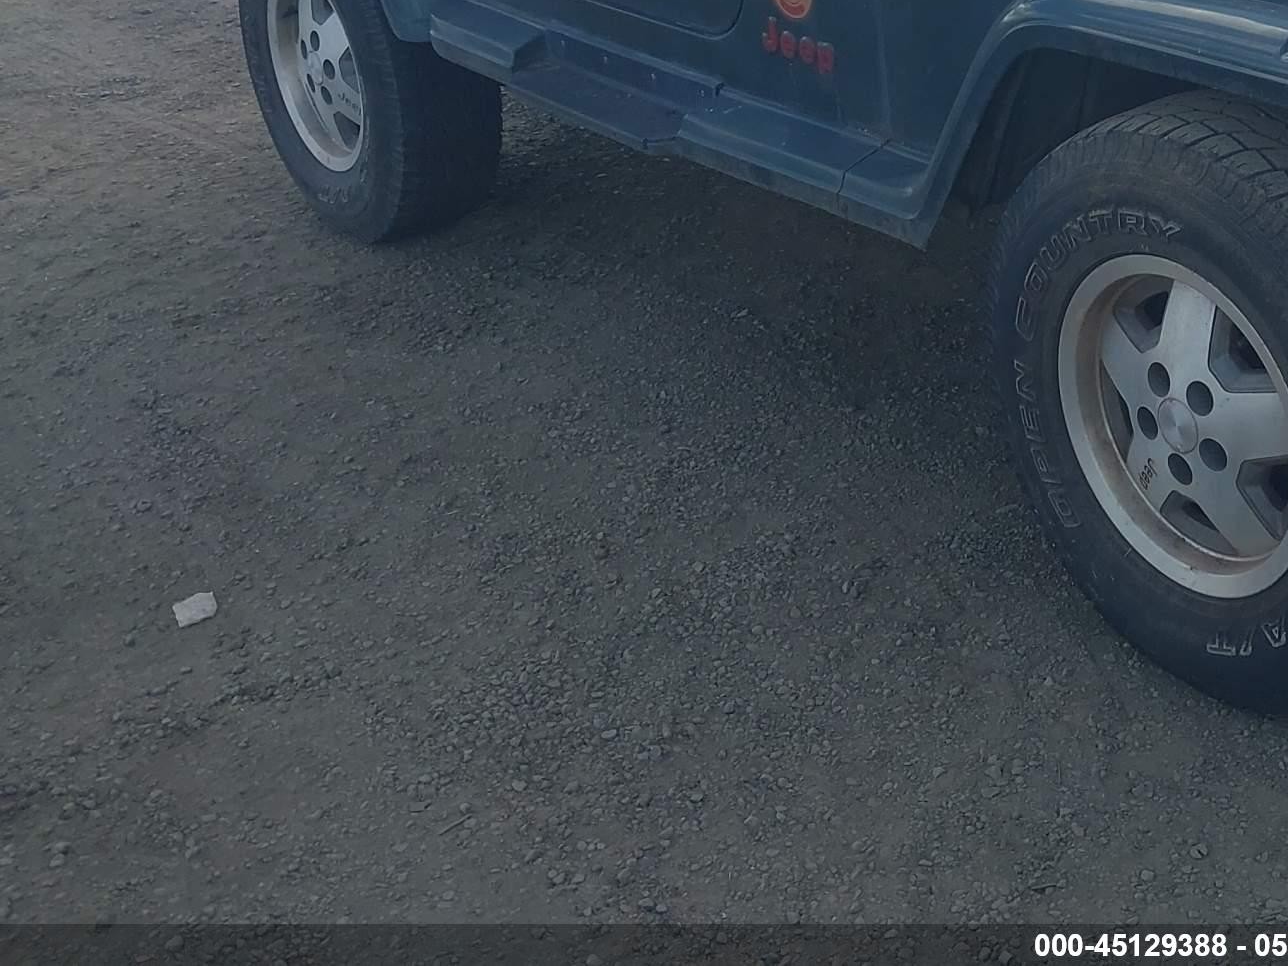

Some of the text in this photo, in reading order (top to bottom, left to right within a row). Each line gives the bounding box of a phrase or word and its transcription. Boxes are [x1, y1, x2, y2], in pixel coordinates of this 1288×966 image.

[762, 16, 834, 74] Jeep
[1013, 207, 1184, 529] OPEN COUNTRY
